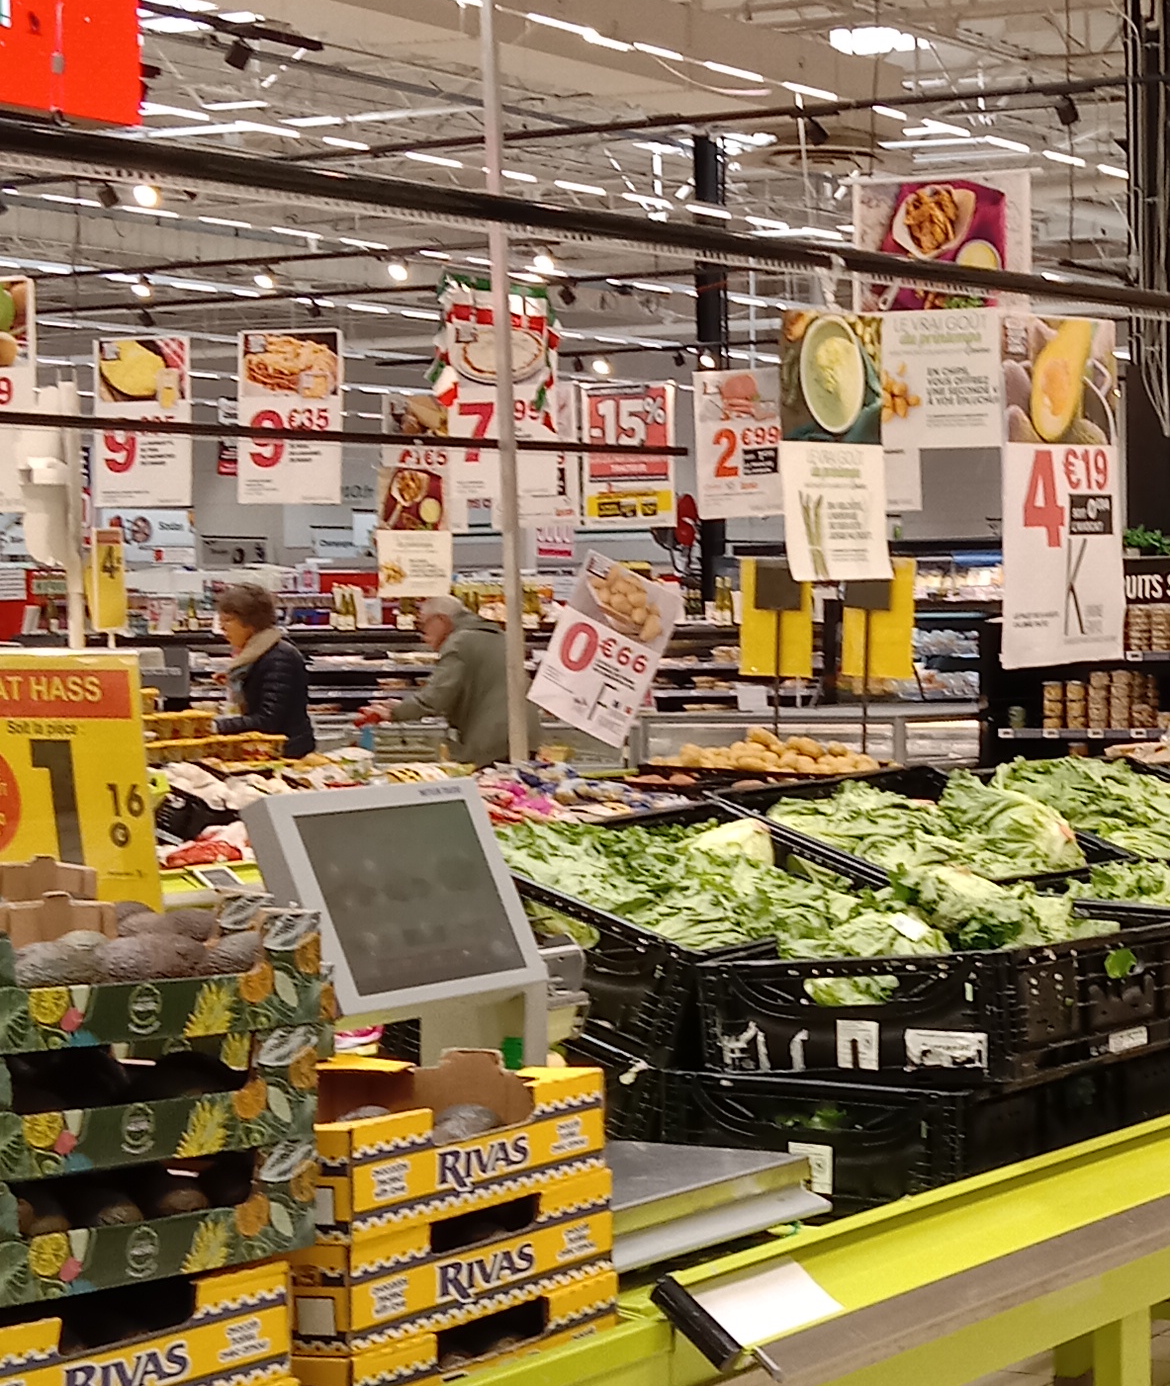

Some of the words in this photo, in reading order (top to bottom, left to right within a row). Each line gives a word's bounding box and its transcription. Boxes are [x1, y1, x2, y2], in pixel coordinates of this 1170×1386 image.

[251, 409, 286, 468] 9
[458, 402, 494, 462] 7
[713, 427, 740, 478] 2
[1023, 449, 1065, 548] 4
[1063, 447, 1110, 490] €19
[1125, 573, 1163, 600] UITS
[560, 622, 599, 672] 0
[599, 638, 647, 674] €66
[29, 676, 102, 702] HASS
[29, 739, 85, 866] 1
[106, 782, 145, 818] 16
[437, 1135, 529, 1190] RIVAS
[437, 1243, 534, 1300] RIVAS
